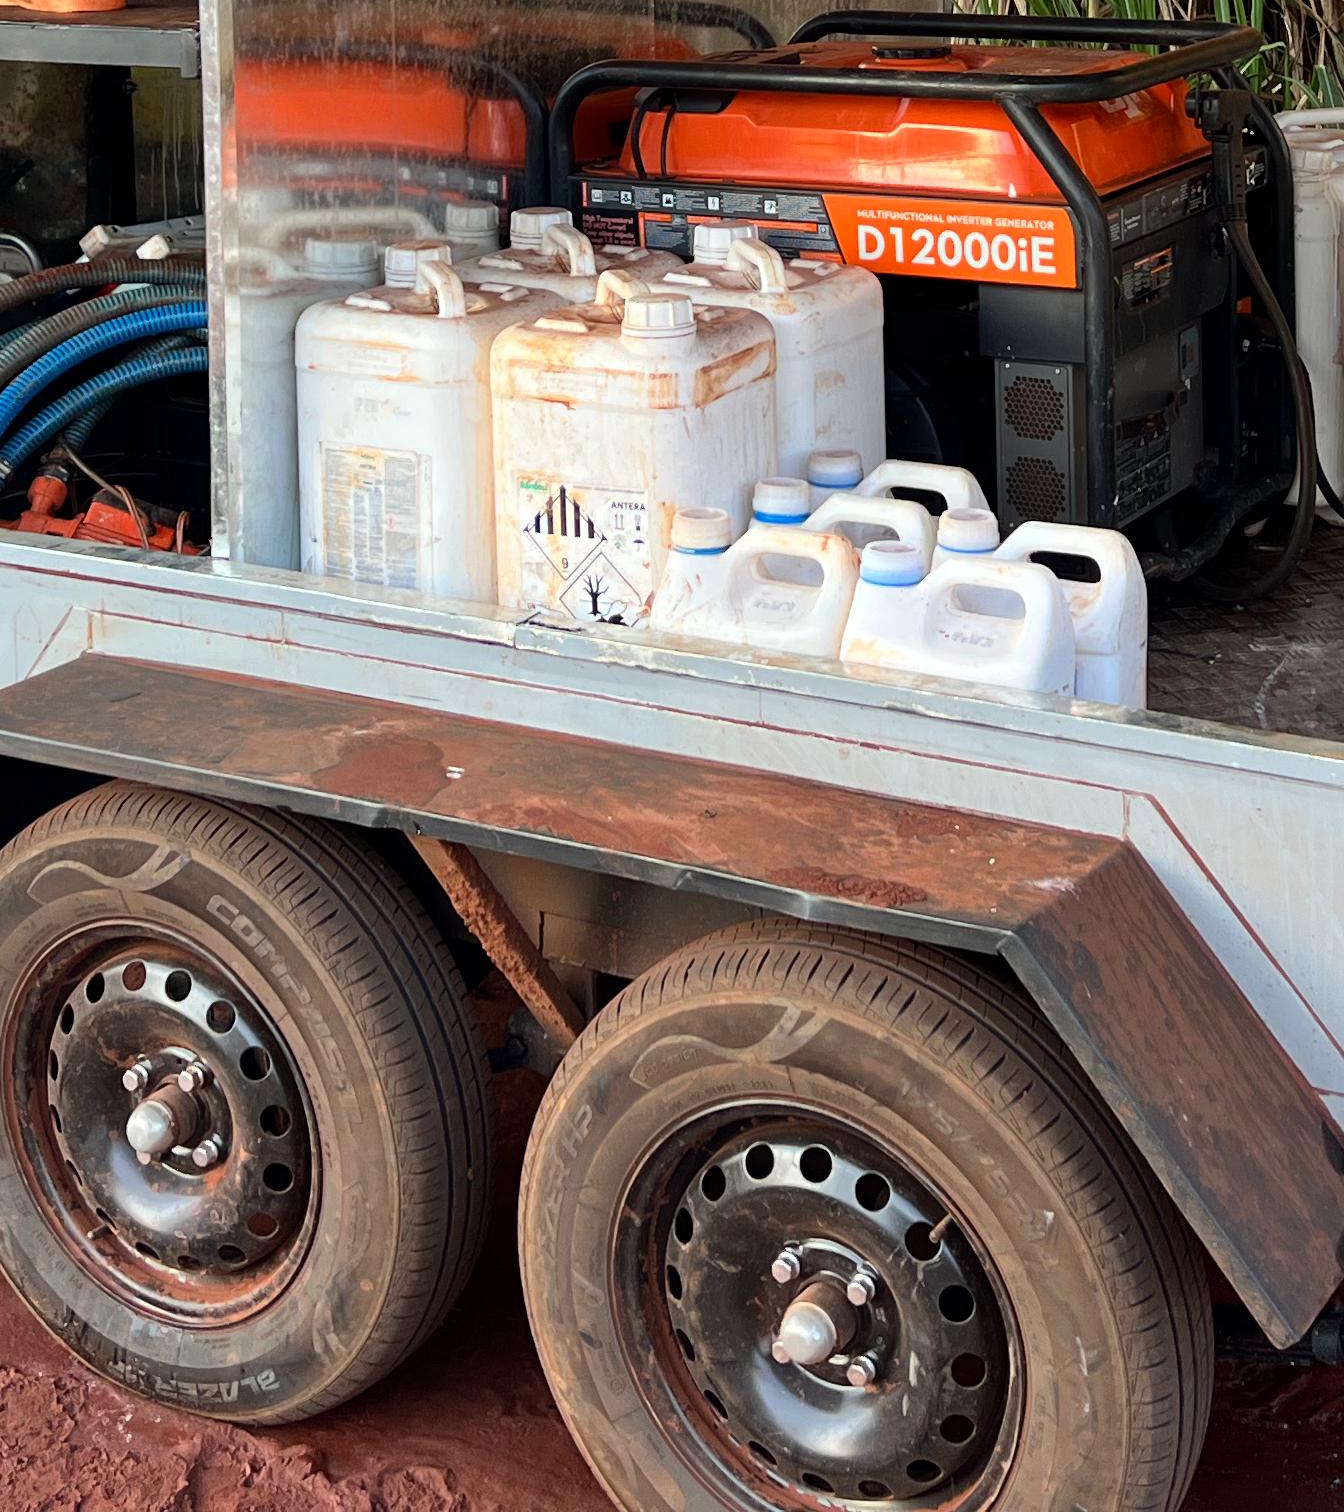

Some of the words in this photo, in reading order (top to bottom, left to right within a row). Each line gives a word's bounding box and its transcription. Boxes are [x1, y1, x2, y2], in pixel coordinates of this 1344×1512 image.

[857, 209, 944, 224] MULTIFUNCTIONAL
[947, 215, 992, 227] INVERTER
[995, 219, 1054, 231] GENERATOR
[857, 224, 1056, 274] D12000iE
[610, 501, 646, 511] ANTERA
[561, 557, 569, 569] 9
